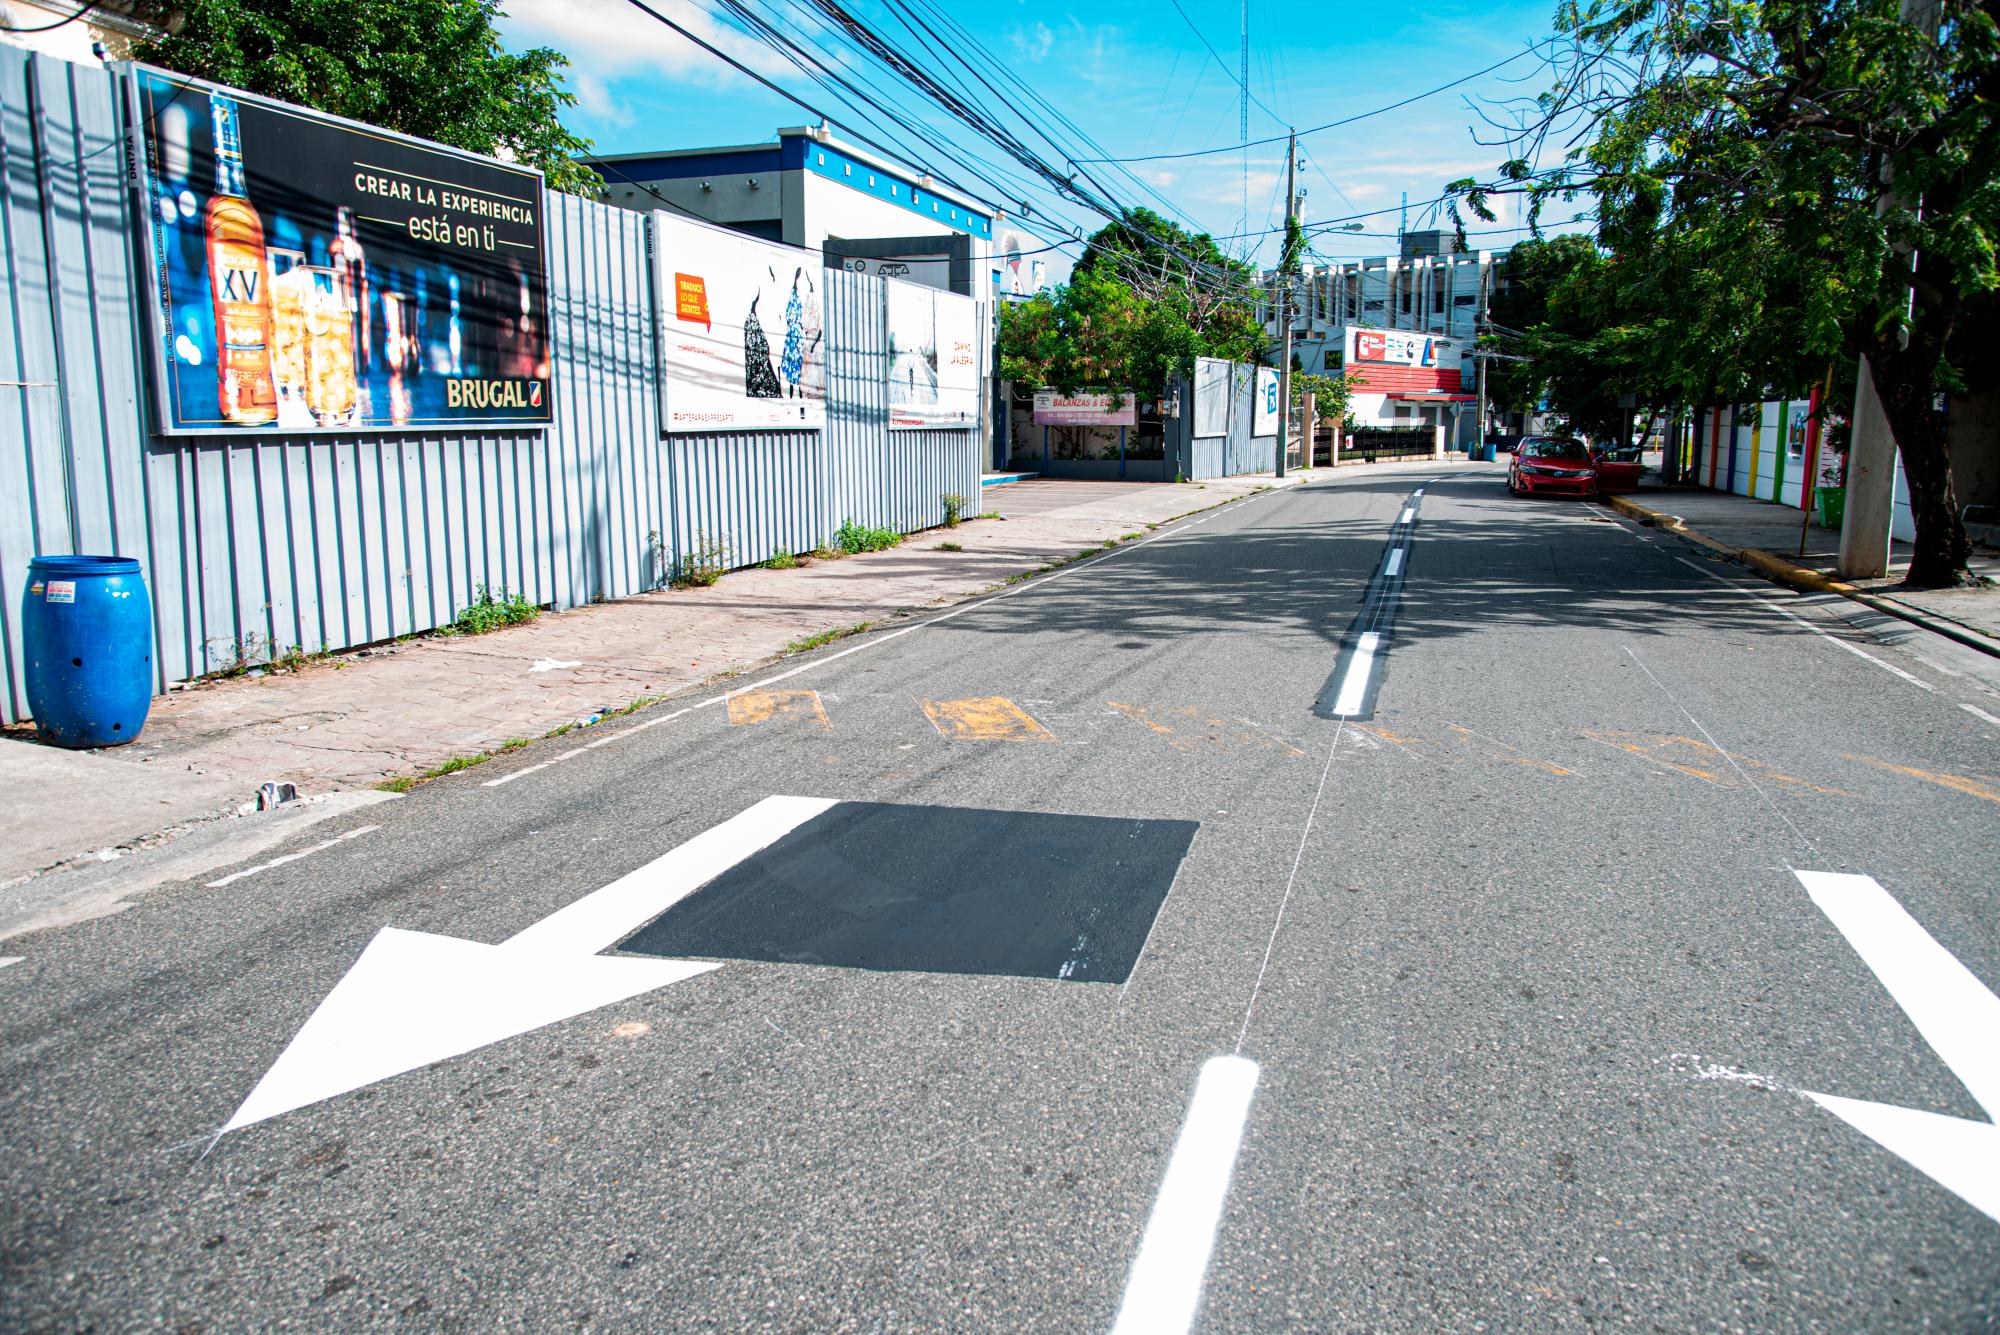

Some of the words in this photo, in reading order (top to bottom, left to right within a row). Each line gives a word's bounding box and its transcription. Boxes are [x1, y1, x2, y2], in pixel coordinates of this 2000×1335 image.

[126, 135, 138, 180] DN175A
[354, 173, 411, 201] CREAR
[416, 186, 437, 206] LA
[441, 191, 534, 225] EXPERIENCIA
[409, 214, 451, 244] está
[456, 223, 479, 248] en
[483, 224, 495, 251] ti
[160, 263, 169, 299] ALCOHOL
[220, 268, 257, 303] XV
[680, 280, 703, 293] TRADUCE
[680, 291, 688, 302] LO
[688, 293, 698, 303] QUE
[446, 379, 527, 408] BRUGAL
[1053, 399, 1091, 407] BALANZAS
[1092, 399, 1098, 407] &
